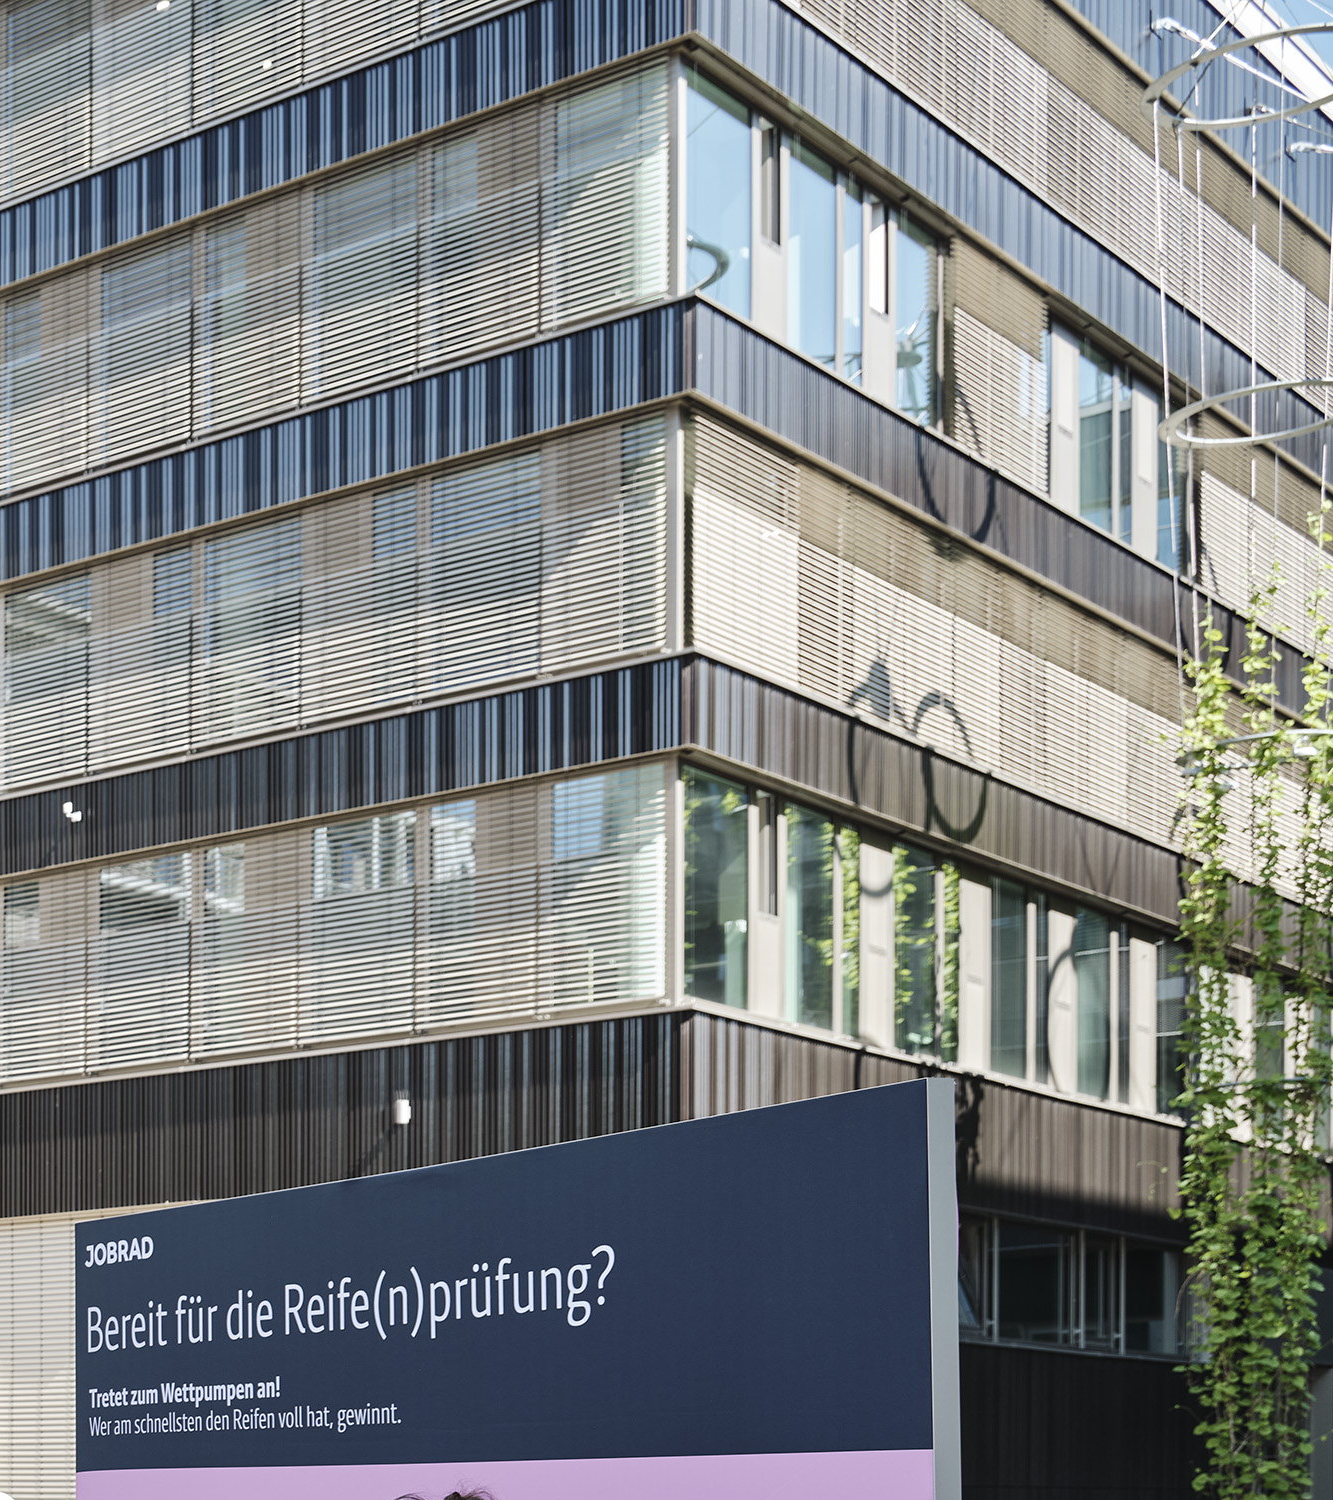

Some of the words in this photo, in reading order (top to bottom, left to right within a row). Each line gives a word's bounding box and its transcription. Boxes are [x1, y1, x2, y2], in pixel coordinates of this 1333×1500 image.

[85, 1236, 154, 1267] JOBRAD
[87, 1300, 168, 1353] Bereit
[175, 1295, 218, 1344] für
[226, 1289, 273, 1340] die
[284, 1244, 615, 1340] Reife(n)prüfung?
[89, 1388, 128, 1408] Tretet
[130, 1387, 158, 1406] zum
[161, 1379, 253, 1407] Wettpumpen
[256, 1375, 281, 1398] an!
[89, 1416, 112, 1437] Wer
[113, 1417, 132, 1436] am
[134, 1410, 203, 1434] schnellsten
[205, 1409, 230, 1431] den
[233, 1407, 275, 1430] Reifen
[278, 1405, 304, 1428] voll
[306, 1405, 334, 1429] hat,
[337, 1402, 402, 1433] gewinnt.
